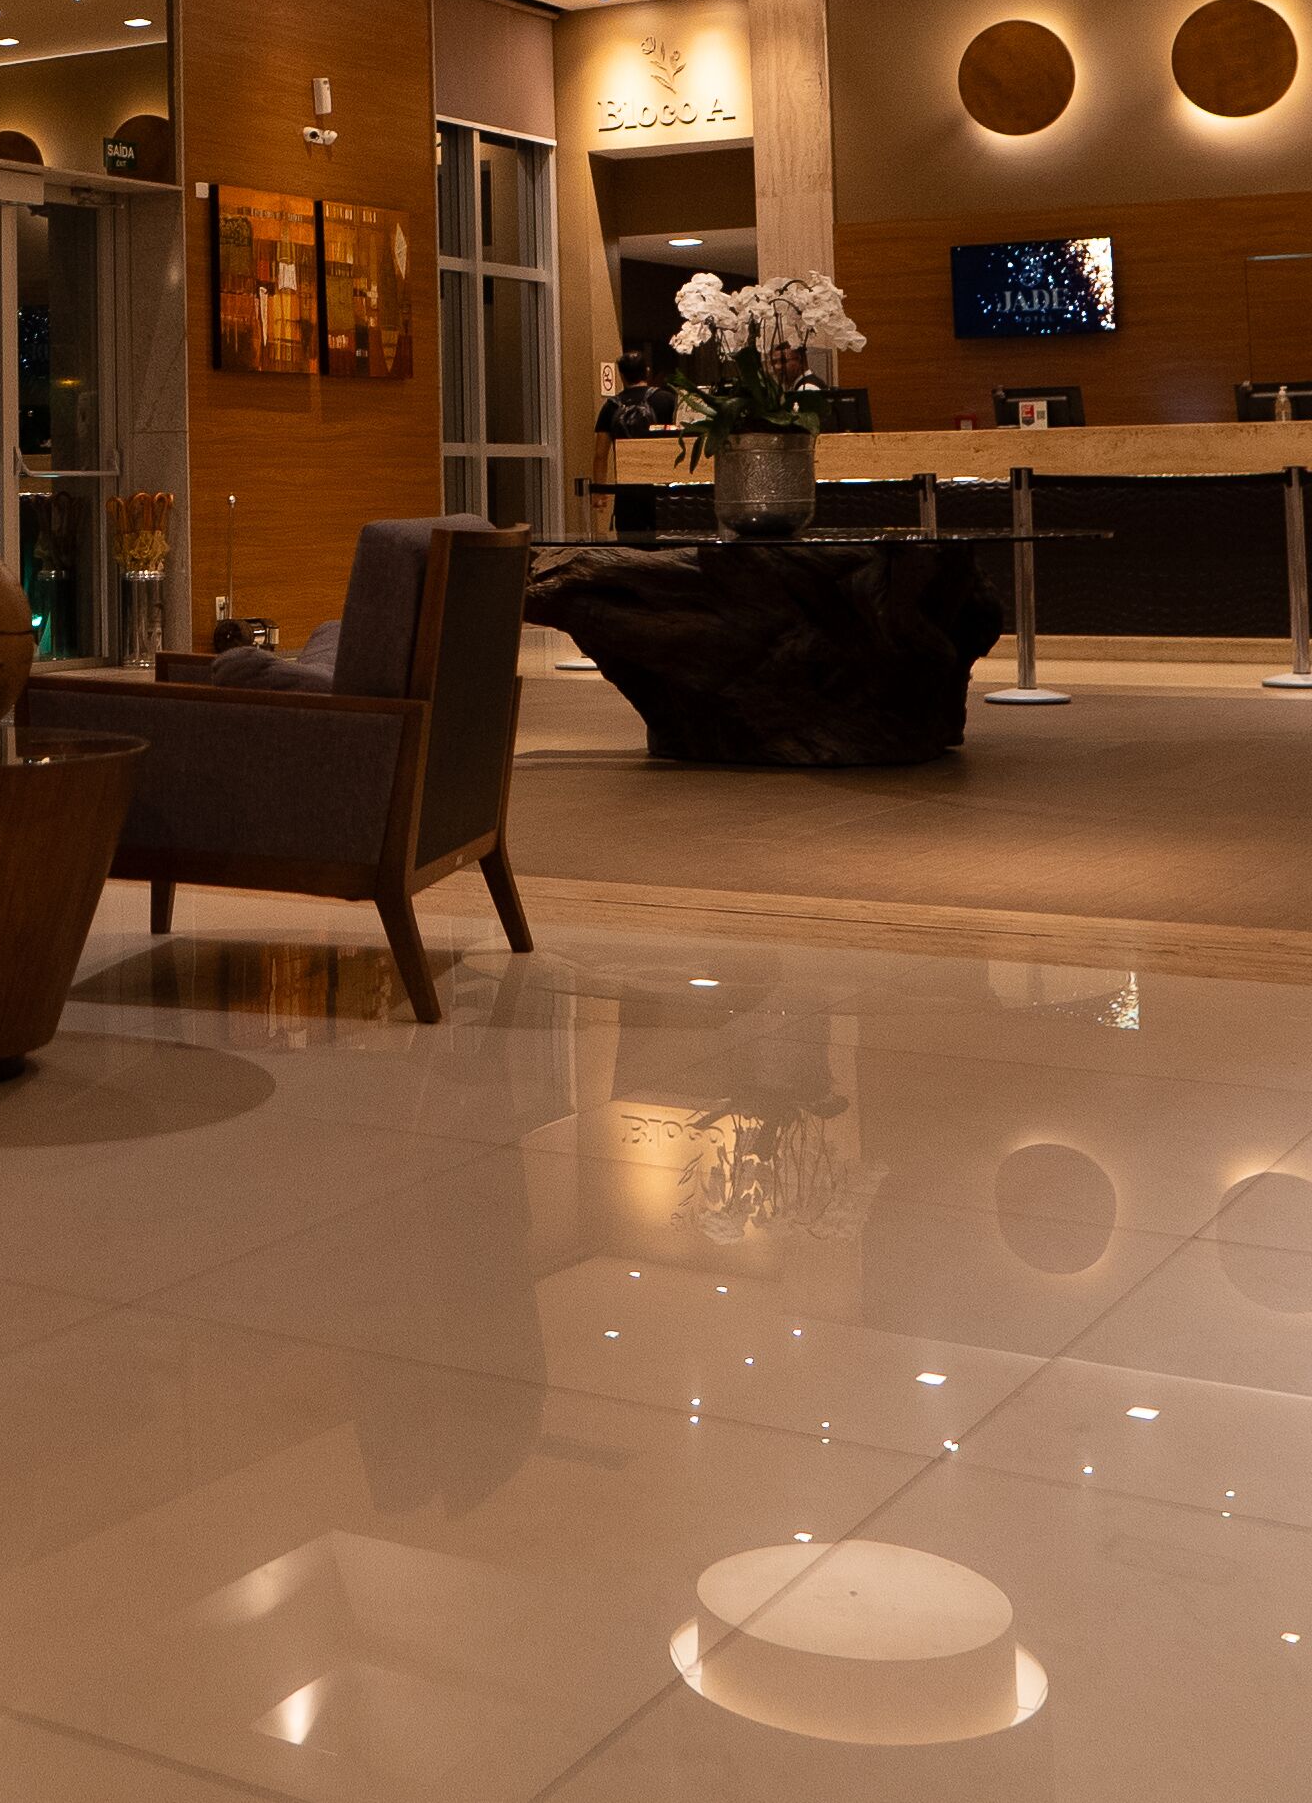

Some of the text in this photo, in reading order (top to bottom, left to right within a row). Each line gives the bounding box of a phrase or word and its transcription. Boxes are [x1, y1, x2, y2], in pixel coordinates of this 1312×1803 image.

[597, 97, 737, 132] Bloco A
[107, 142, 135, 159] SAÍDA
[996, 287, 1070, 312] JADE
